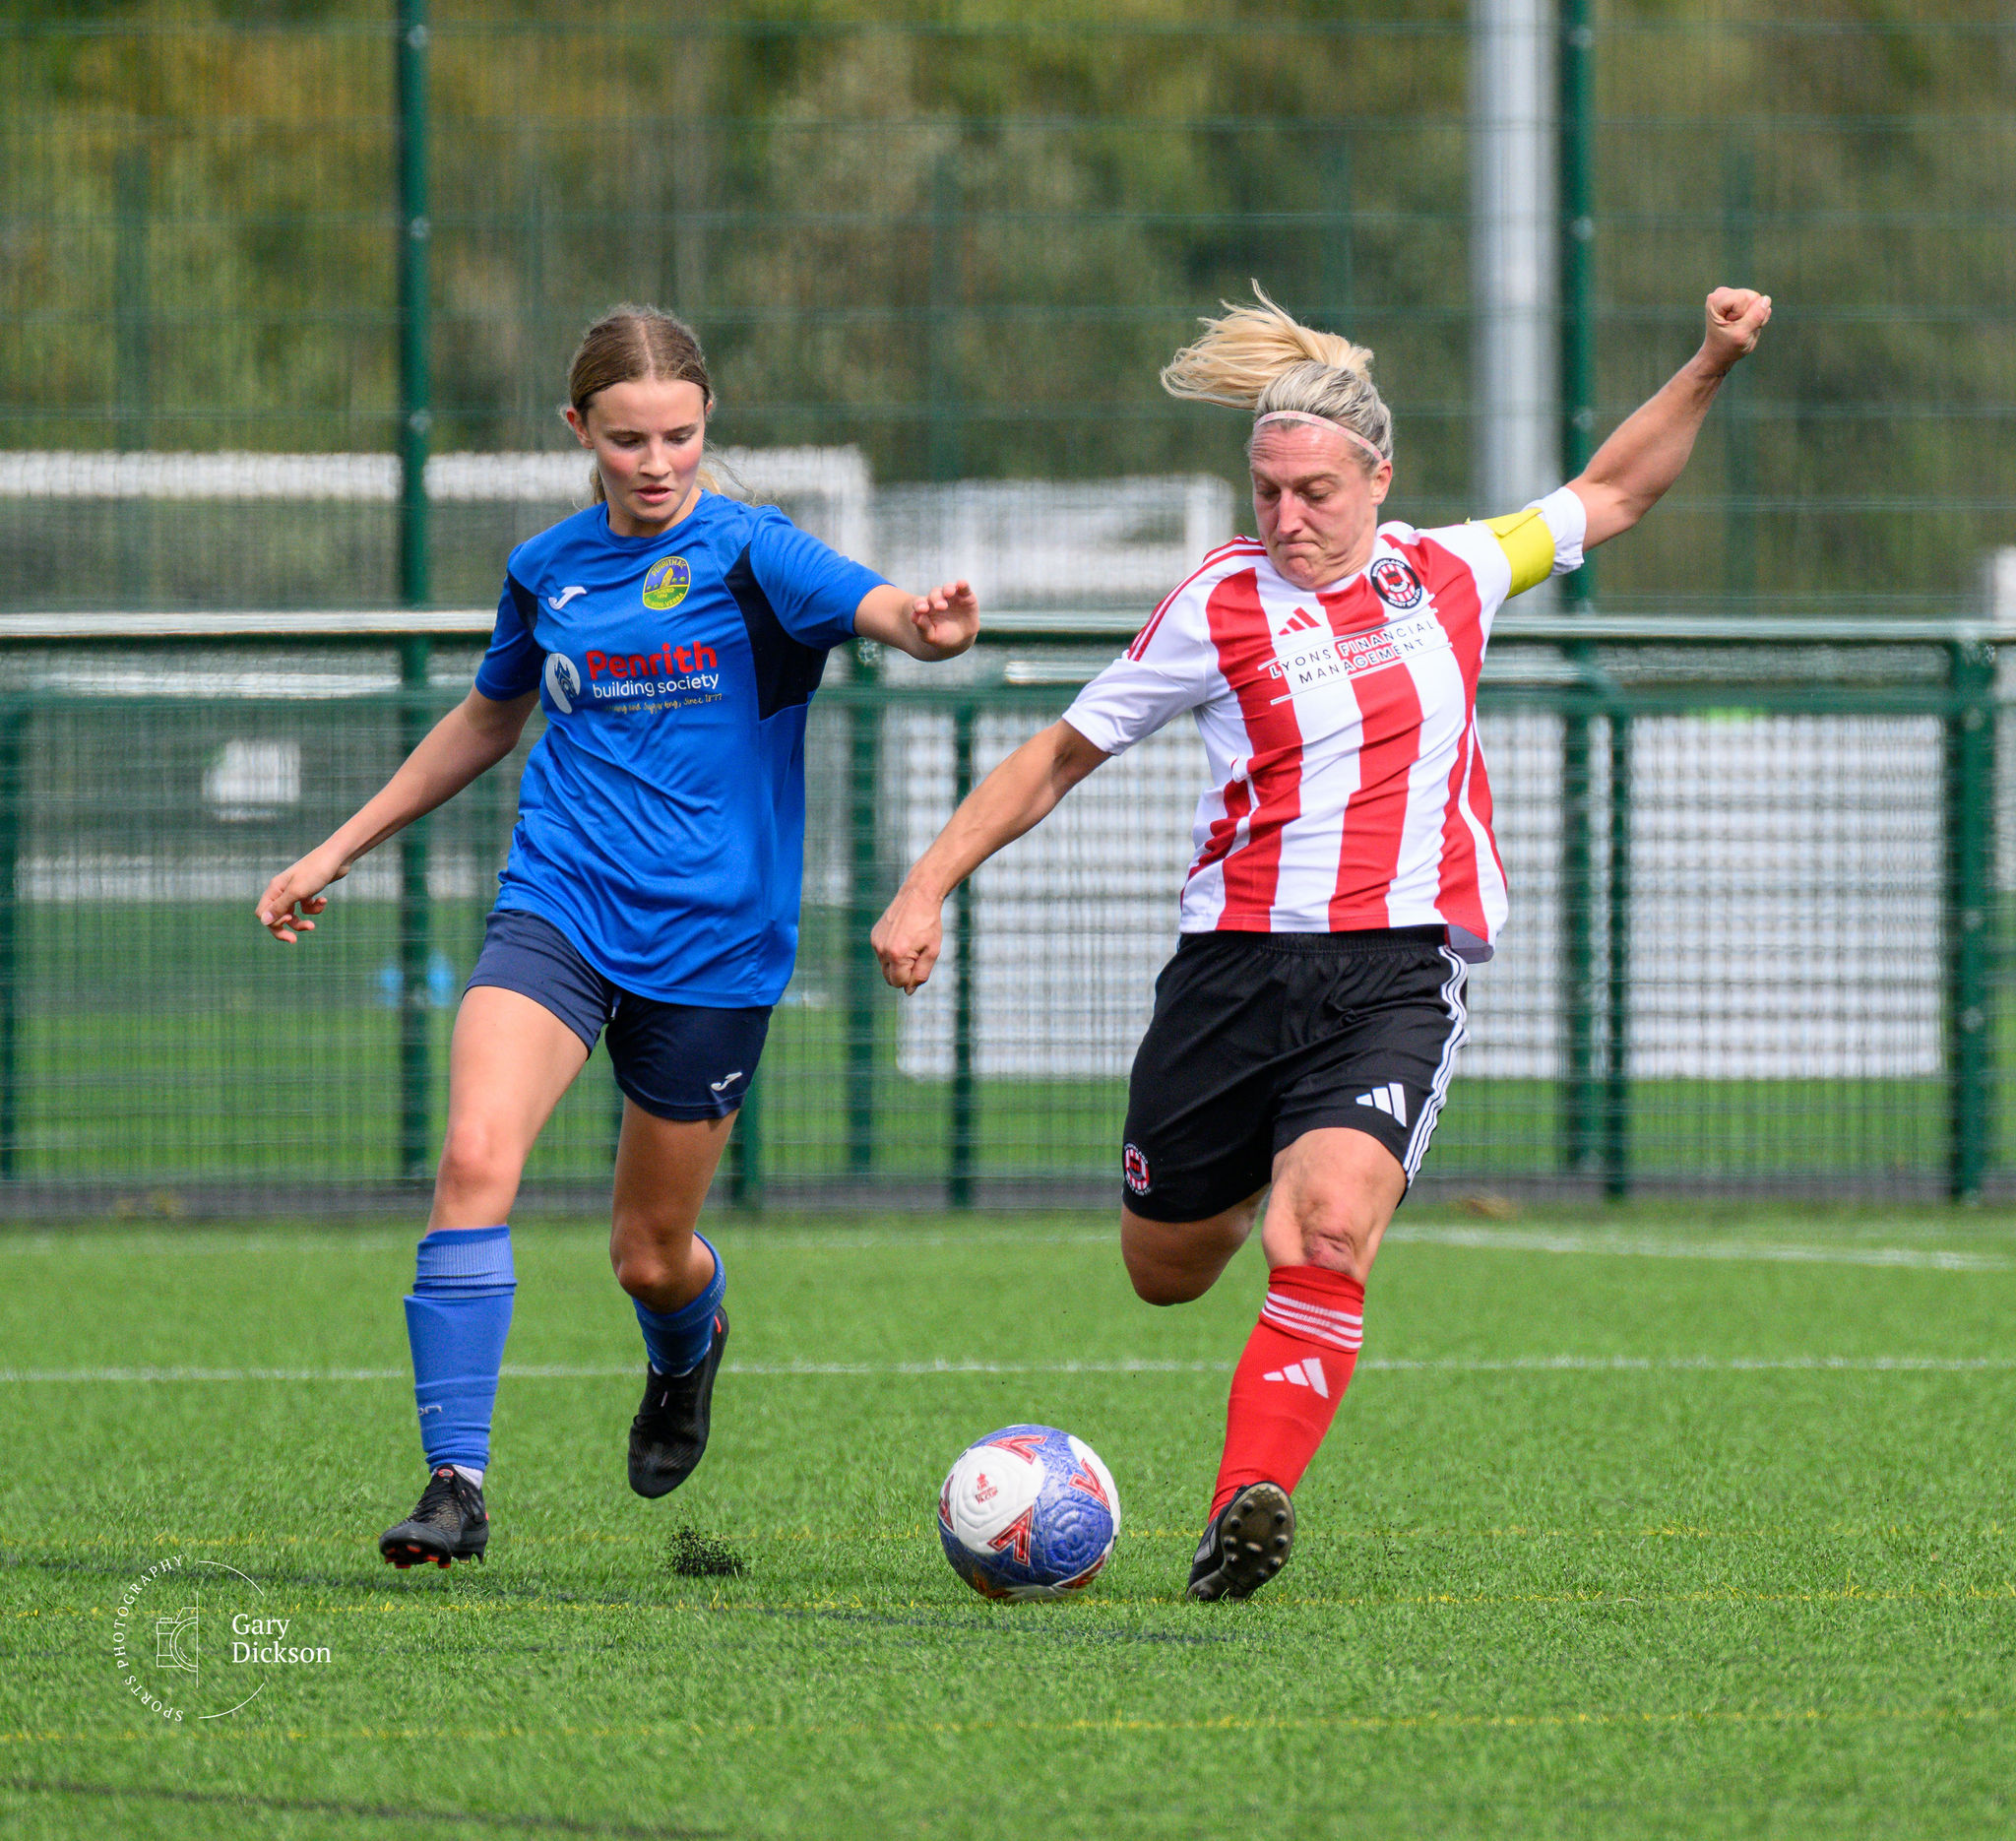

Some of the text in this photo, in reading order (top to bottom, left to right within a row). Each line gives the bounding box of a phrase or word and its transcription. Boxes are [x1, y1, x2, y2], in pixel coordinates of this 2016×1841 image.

[586, 641, 718, 680] Penrith
[1271, 619, 1434, 679] LYONS FINANCIAL
[1298, 638, 1425, 684] MANAGEMENT
[593, 673, 720, 699] building society
